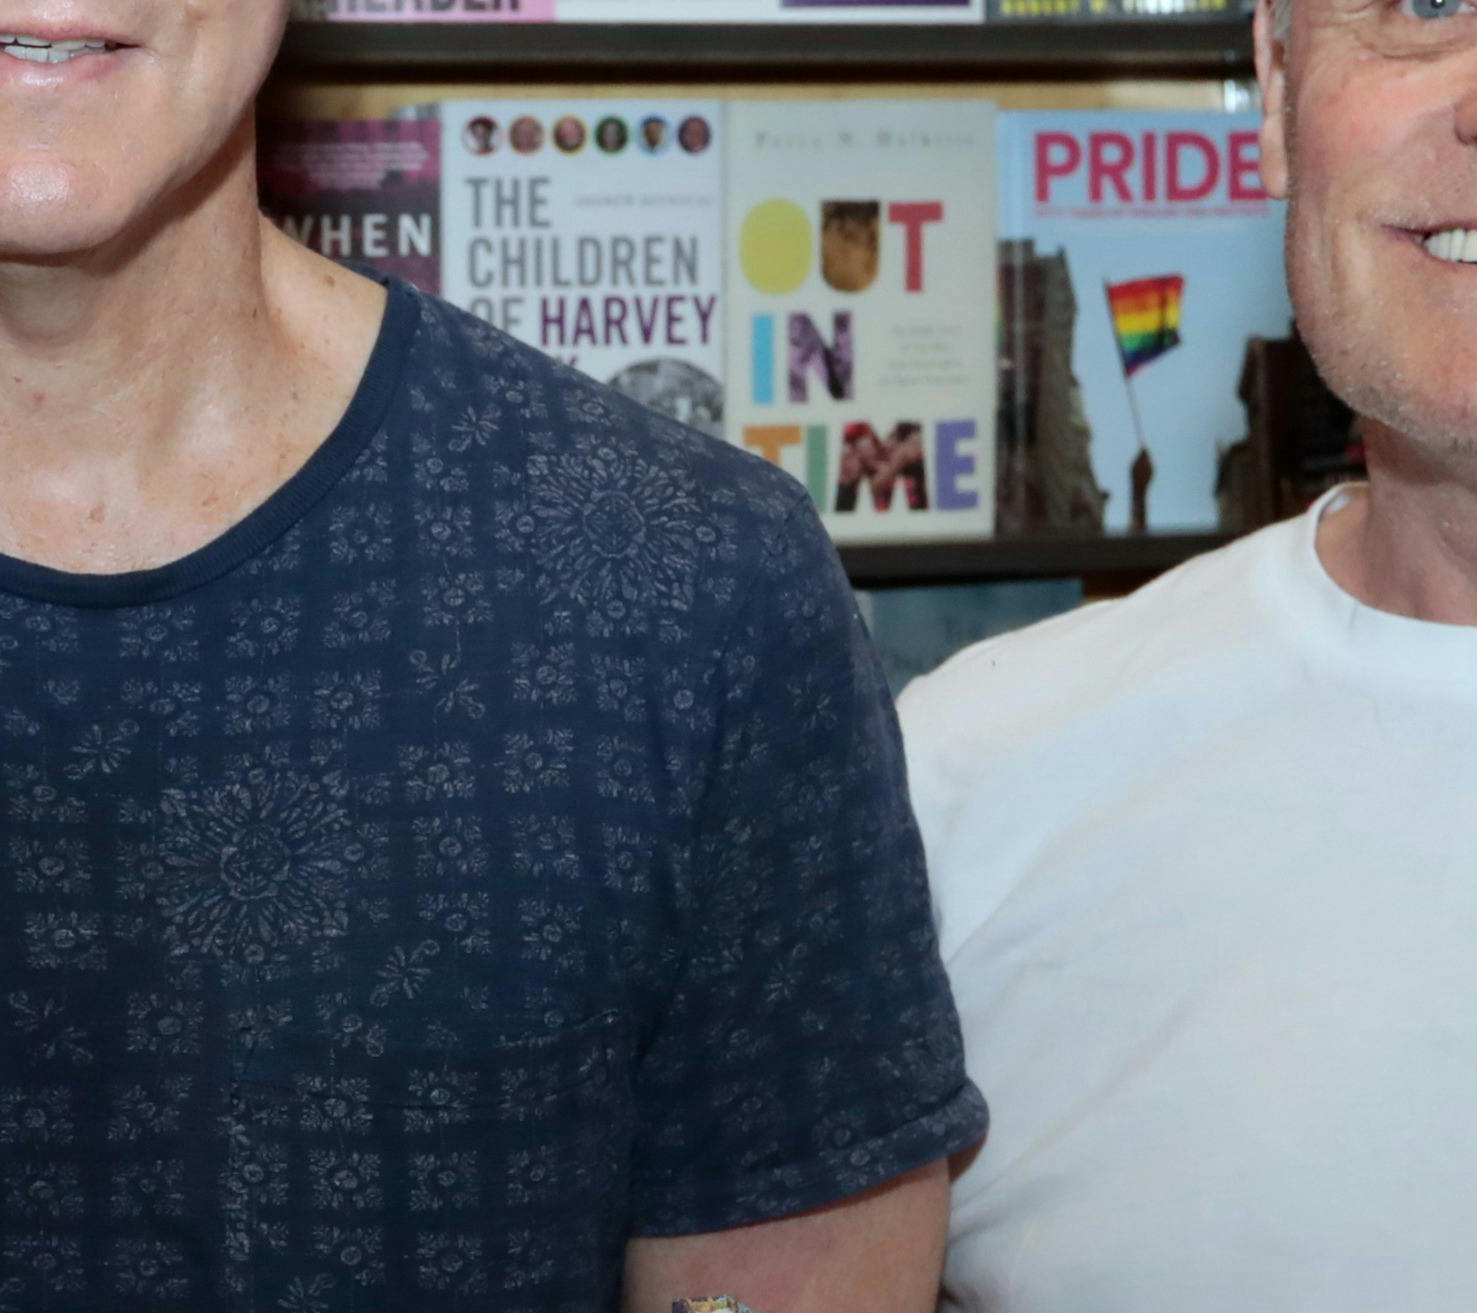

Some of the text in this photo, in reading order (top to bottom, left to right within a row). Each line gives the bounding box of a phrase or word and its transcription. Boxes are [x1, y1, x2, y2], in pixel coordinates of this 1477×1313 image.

[1034, 131, 1267, 204] PRIDE
[282, 211, 434, 259] WHEN
[464, 177, 554, 229] THE
[468, 234, 700, 288] CHILDREN
[739, 197, 944, 296] OUT
[538, 293, 719, 349] HARVEY
[751, 310, 853, 405] IN
[742, 418, 979, 514] TIME
